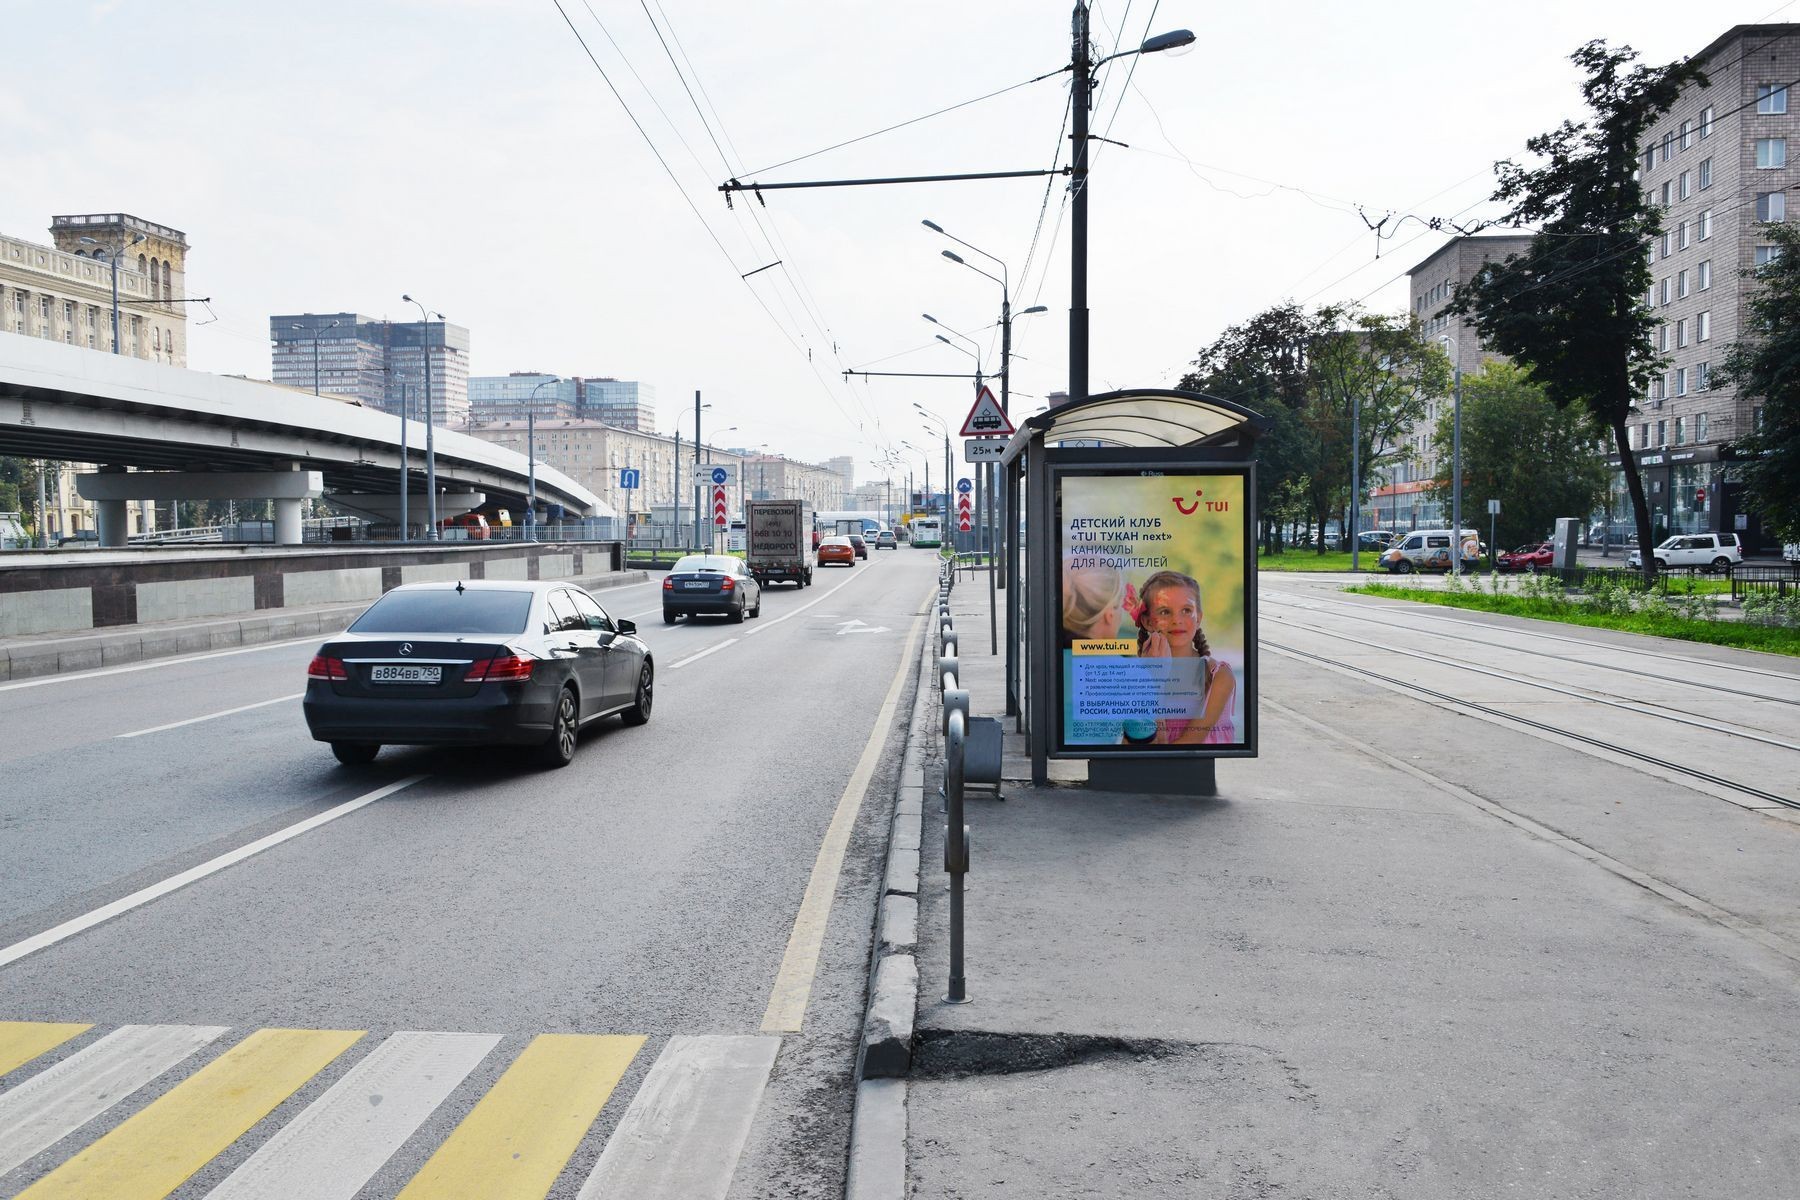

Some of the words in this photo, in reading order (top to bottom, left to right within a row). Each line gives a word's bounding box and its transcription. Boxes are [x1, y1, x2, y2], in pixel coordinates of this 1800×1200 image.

[973, 446, 991, 455] 25м
[1205, 501, 1228, 512] TUI
[1071, 517, 1125, 530] ДЕТСКИЙ
[1130, 518, 1161, 528] КЛУБ
[1071, 531, 1097, 542] «TUI
[1100, 531, 1139, 542] ТУКАН
[1142, 532, 1173, 542] next»
[754, 543, 795, 551] НЕДОРОГО
[1071, 544, 1133, 555] КАНИКУЛЫ
[1070, 558, 1095, 570] ДЛЯ
[1099, 556, 1168, 570] РОДИТЕЛЕЙ
[1081, 642, 1129, 651] www.tui.ru
[422, 667, 440, 676] 750
[1152, 707, 1186, 715] ИСПАНИИ
